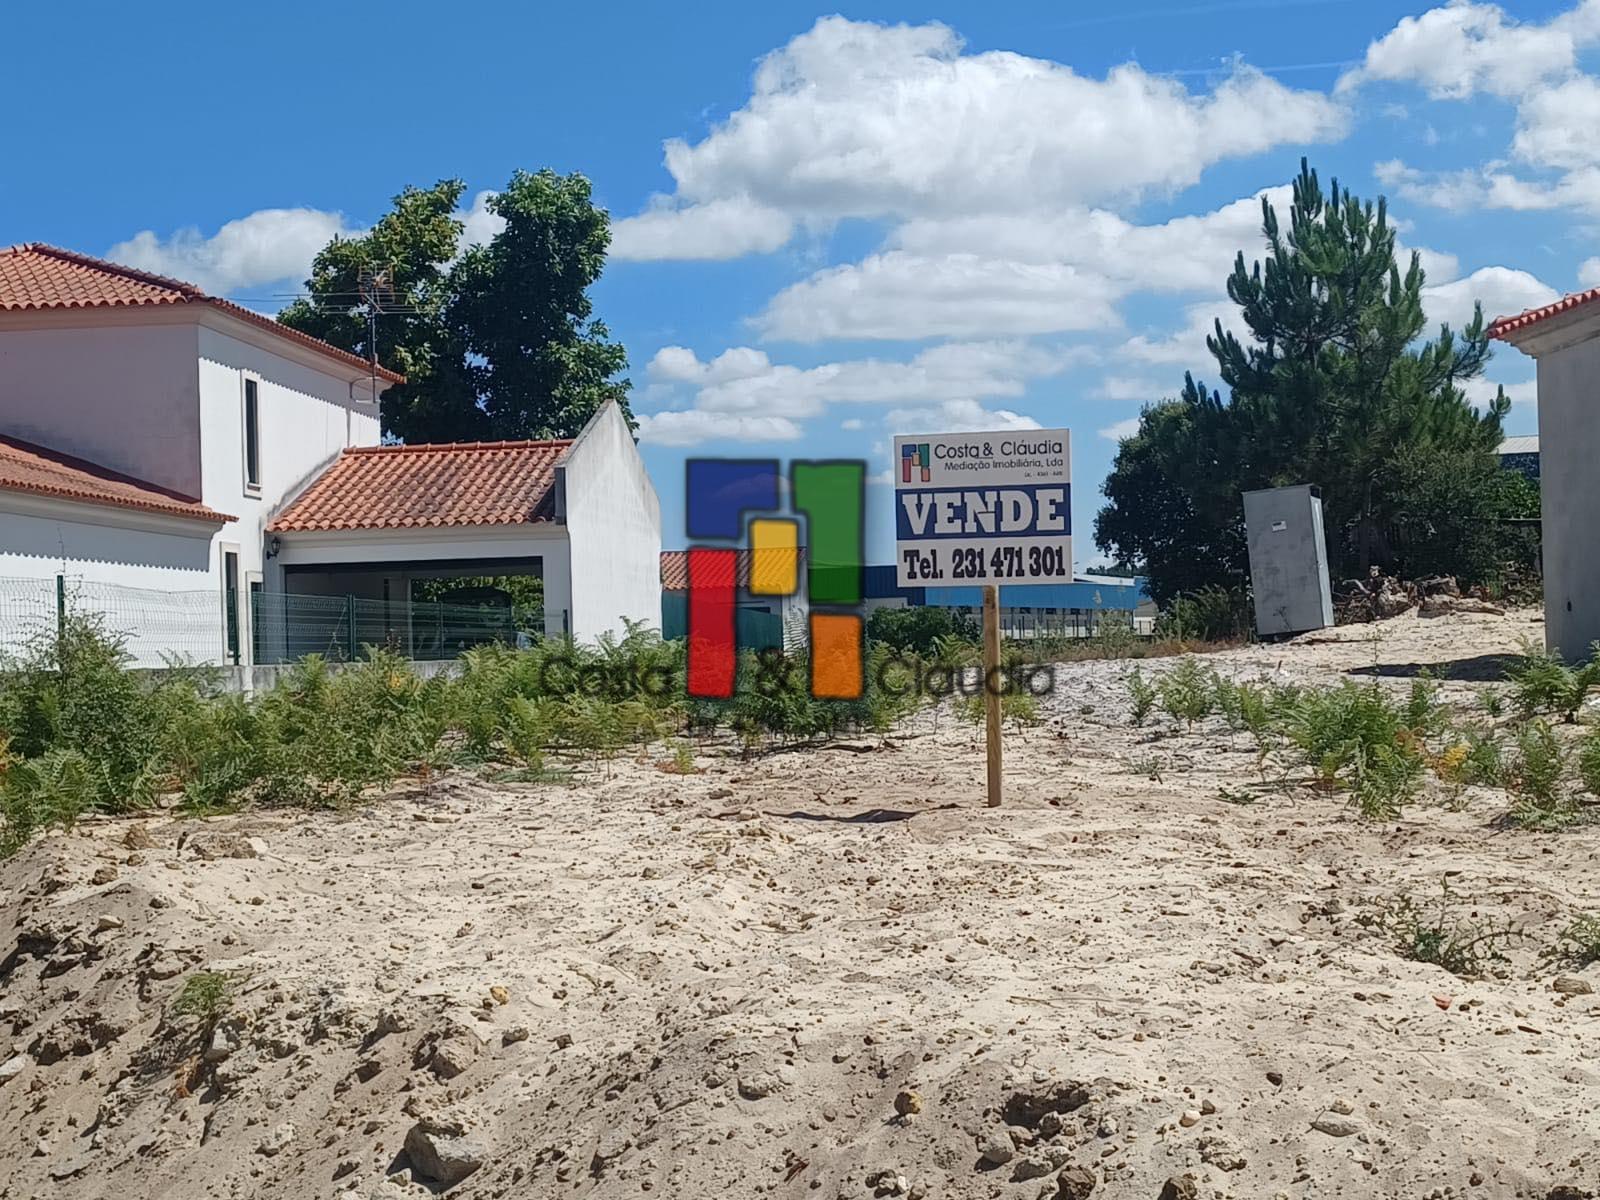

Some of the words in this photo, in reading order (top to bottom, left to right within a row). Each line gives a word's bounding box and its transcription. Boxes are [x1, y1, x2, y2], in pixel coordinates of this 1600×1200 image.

[934, 443, 980, 459] Costa
[983, 442, 994, 457] &
[1001, 439, 1062, 456] Cláudia
[944, 461, 990, 471] Mediação
[1046, 458, 1064, 467] Lda
[902, 488, 1065, 535] VENDE
[904, 549, 943, 580] Tel.
[952, 547, 987, 579] 231
[990, 546, 1025, 578] 471
[1029, 545, 1066, 577] 301
